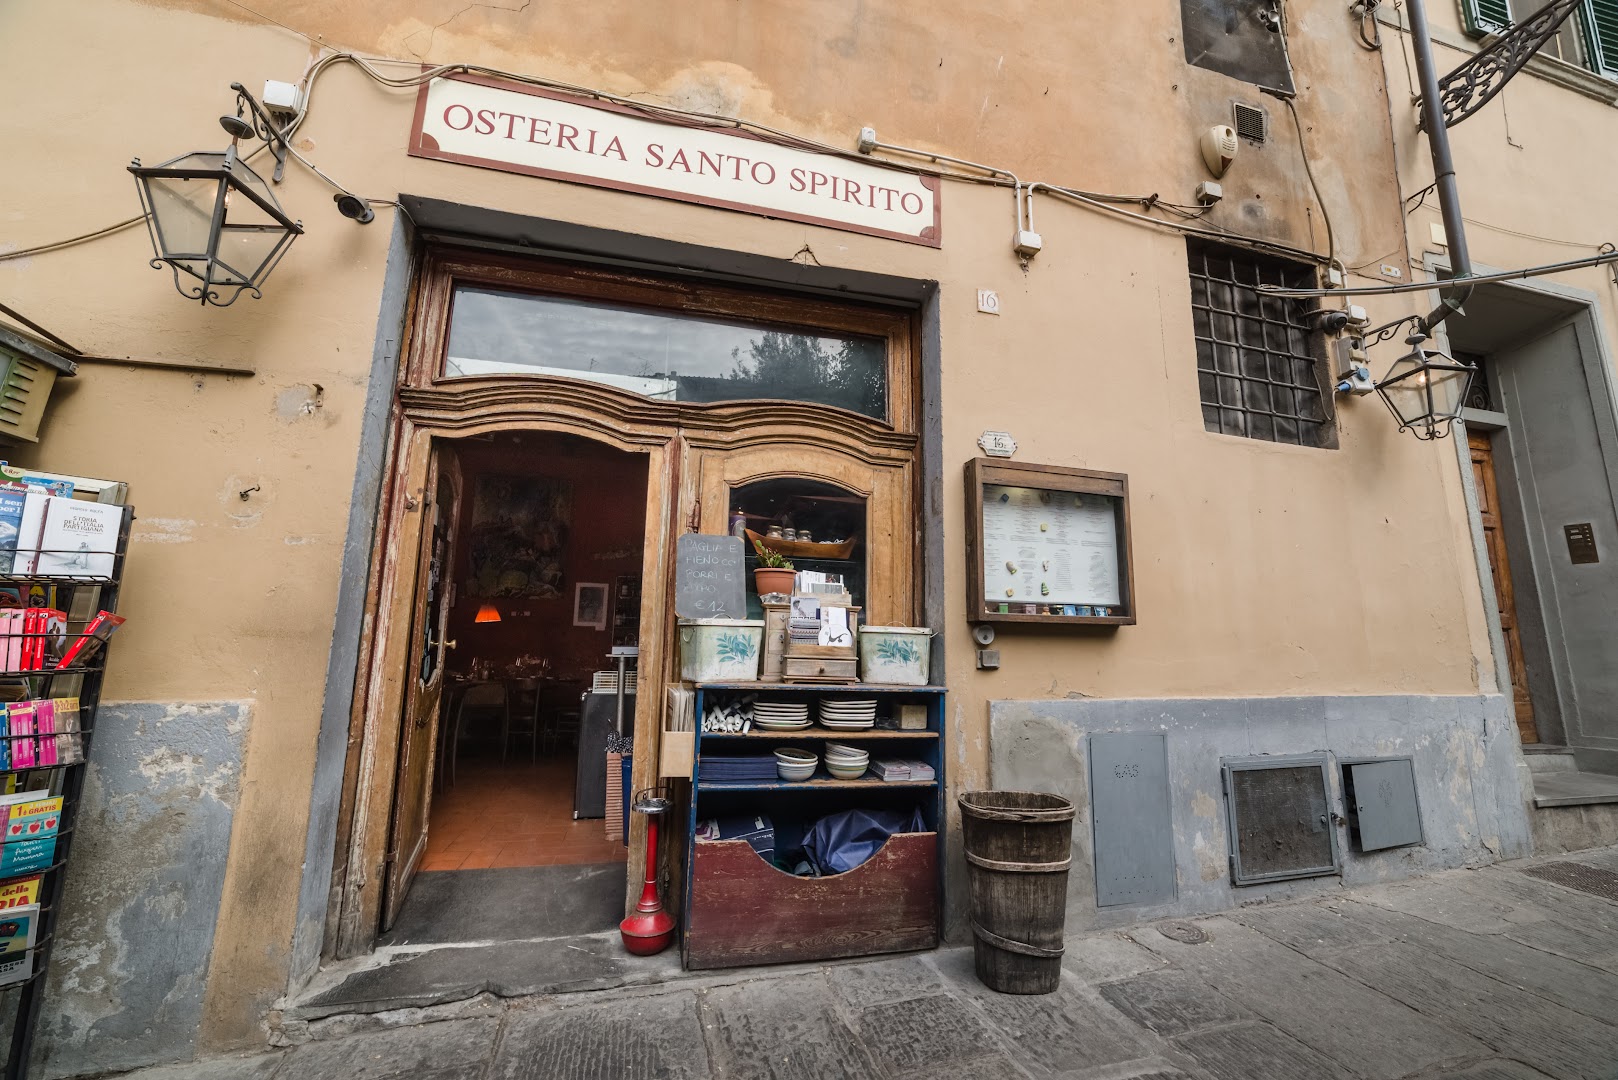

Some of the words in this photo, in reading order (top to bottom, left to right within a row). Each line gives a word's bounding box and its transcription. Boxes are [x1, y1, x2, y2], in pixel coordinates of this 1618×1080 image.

[442, 103, 630, 162] OSTERIA
[644, 142, 777, 186] SANTO
[788, 167, 925, 216] SPIRITO
[981, 293, 997, 309] 16
[63, 519, 104, 528] DELL'ITALIA
[73, 515, 98, 524] STORIA
[63, 523, 104, 533] PARTIGIANA
[684, 538, 723, 552] PAGLIA
[729, 544, 738, 553] E
[685, 568, 718, 580] PORRI
[724, 573, 732, 581] E
[708, 600, 726, 612] 12
[16, 805, 23, 817] 1
[28, 804, 57, 815] GRATIS
[1, 884, 30, 897] della
